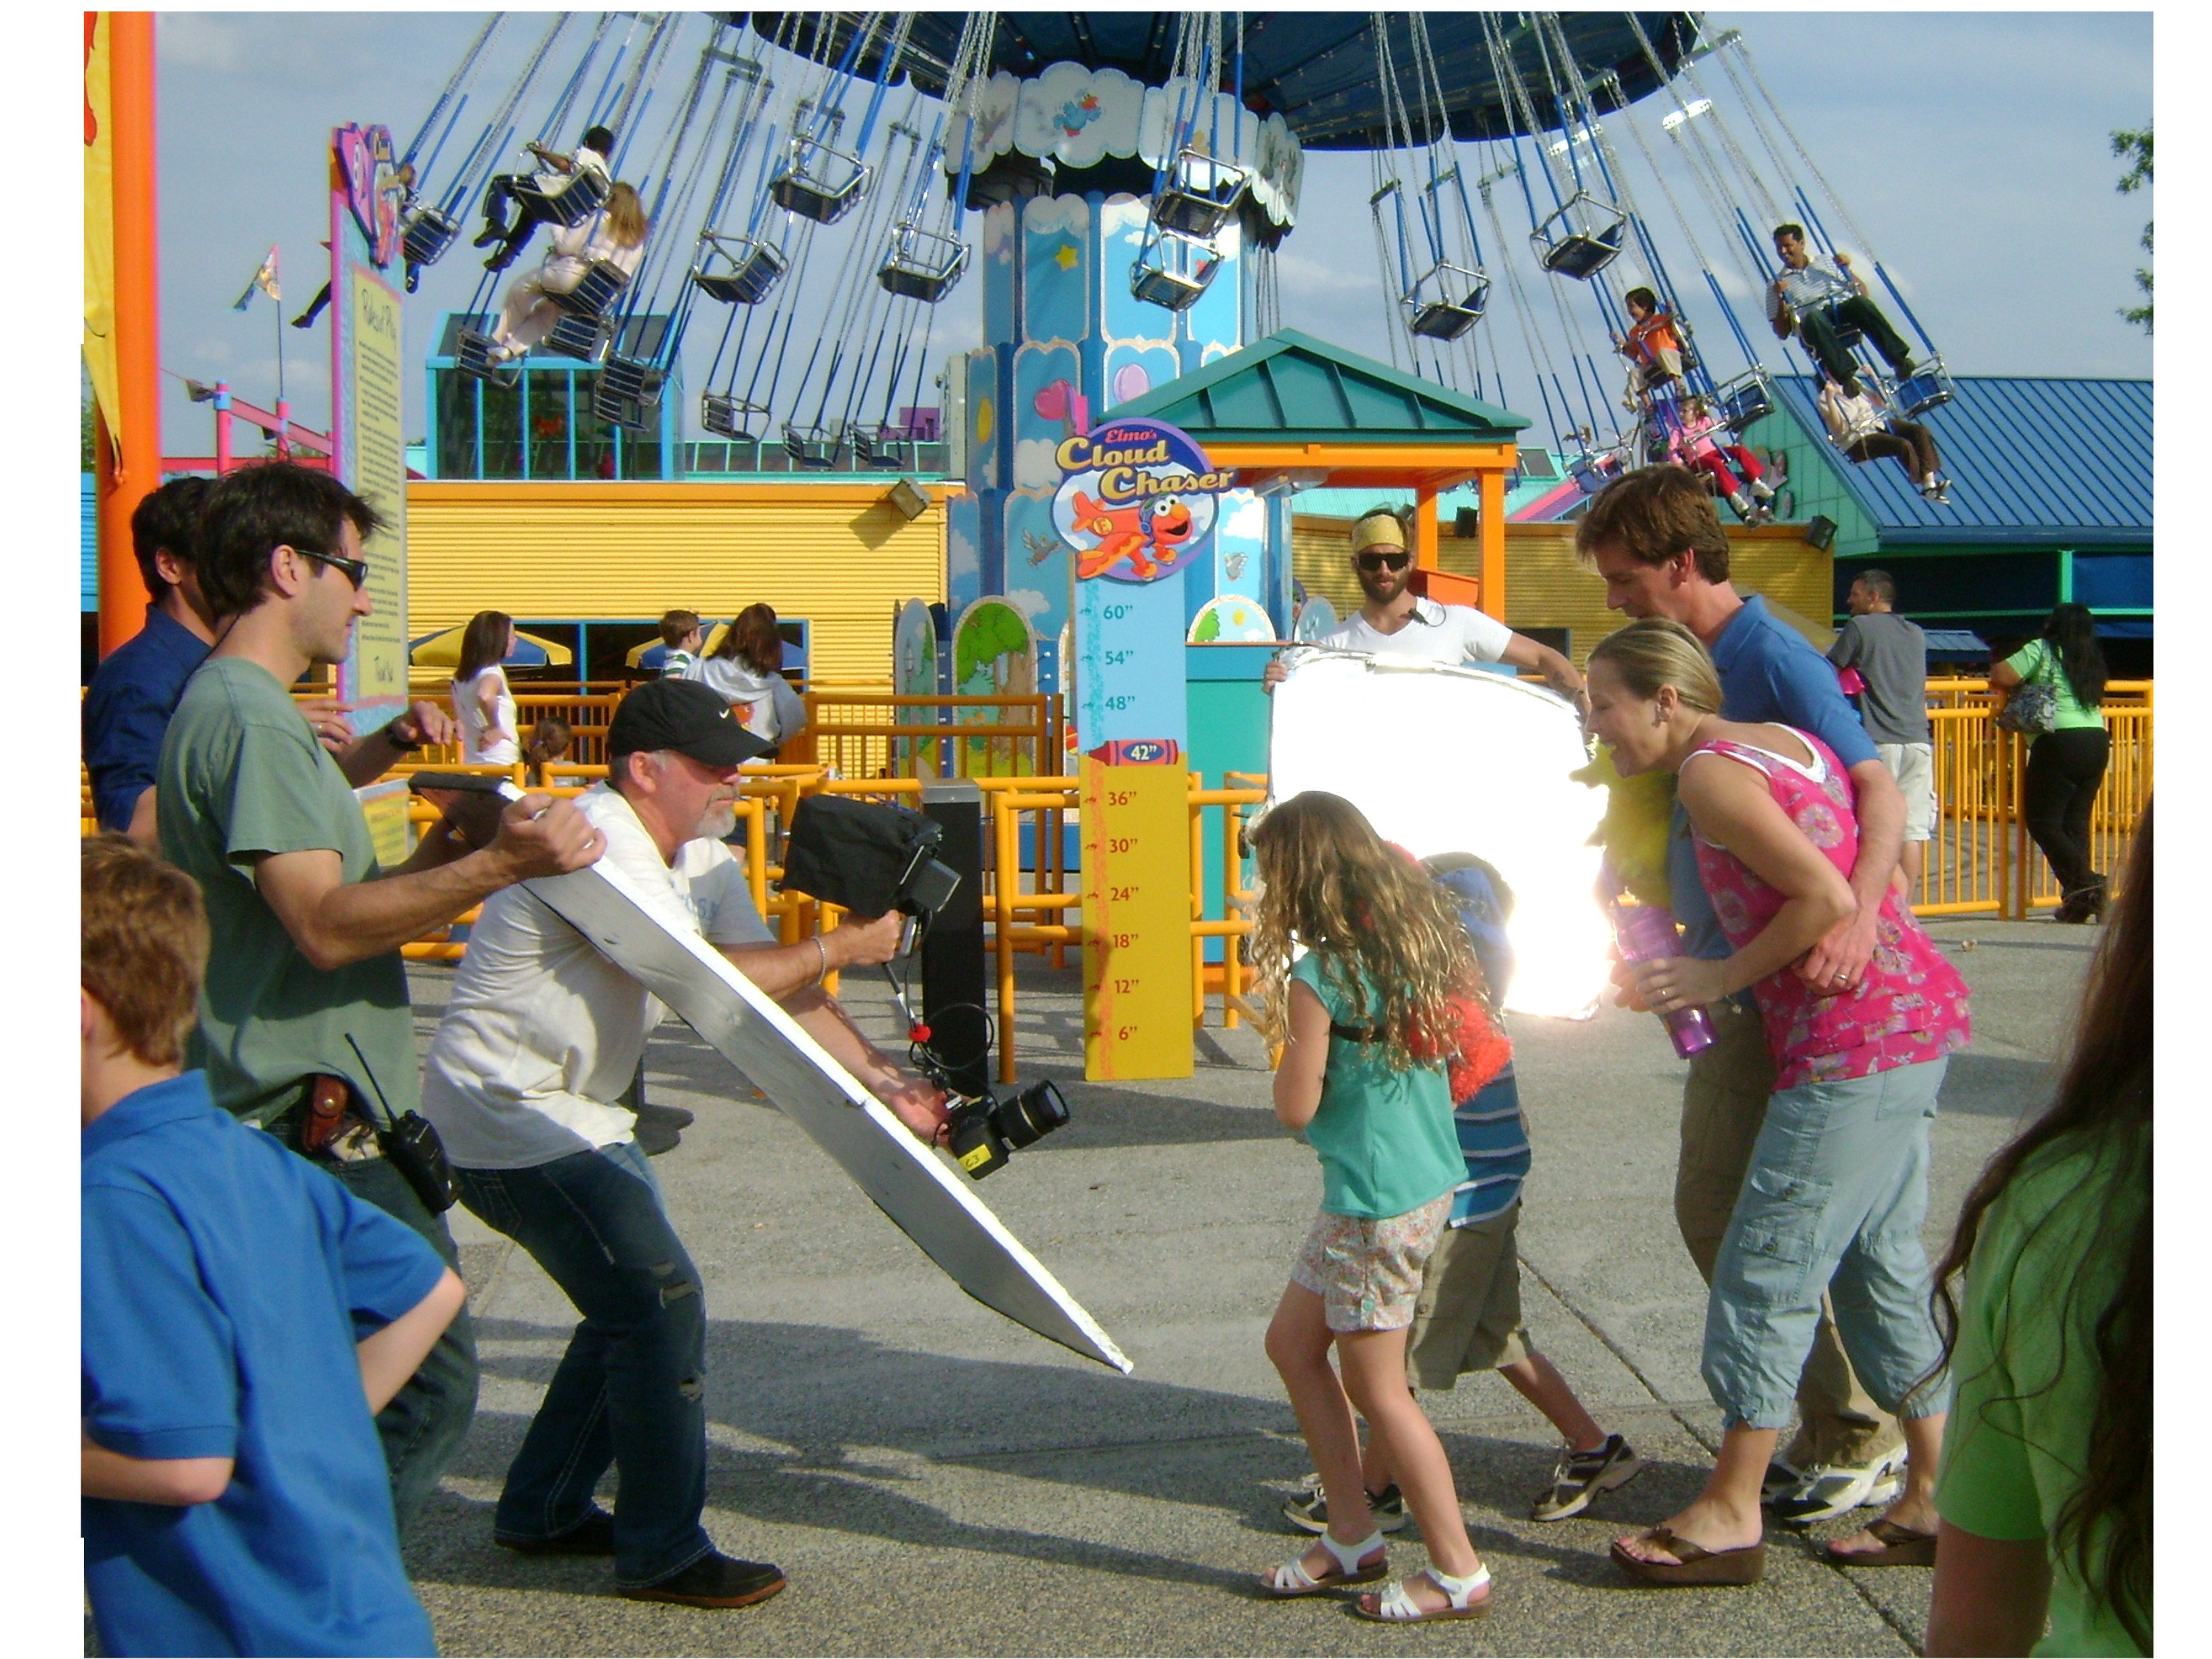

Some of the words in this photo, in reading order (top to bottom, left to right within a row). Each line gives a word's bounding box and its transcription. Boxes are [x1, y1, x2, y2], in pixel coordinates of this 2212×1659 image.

[1105, 429, 1157, 444] Elmo's
[1056, 436, 1170, 470] Cloud
[1100, 467, 1235, 500] Chaser
[1103, 605, 1133, 619] 60"
[1105, 651, 1134, 665] 54"
[1105, 696, 1135, 711] 48"
[1130, 745, 1157, 761] 42"
[1108, 792, 1136, 806] 36"
[1109, 838, 1138, 853] 30"
[1111, 887, 1139, 901] 24"
[1113, 934, 1139, 947] 18"
[1115, 979, 1139, 994] 12"
[1118, 1026, 1138, 1040] 6"
